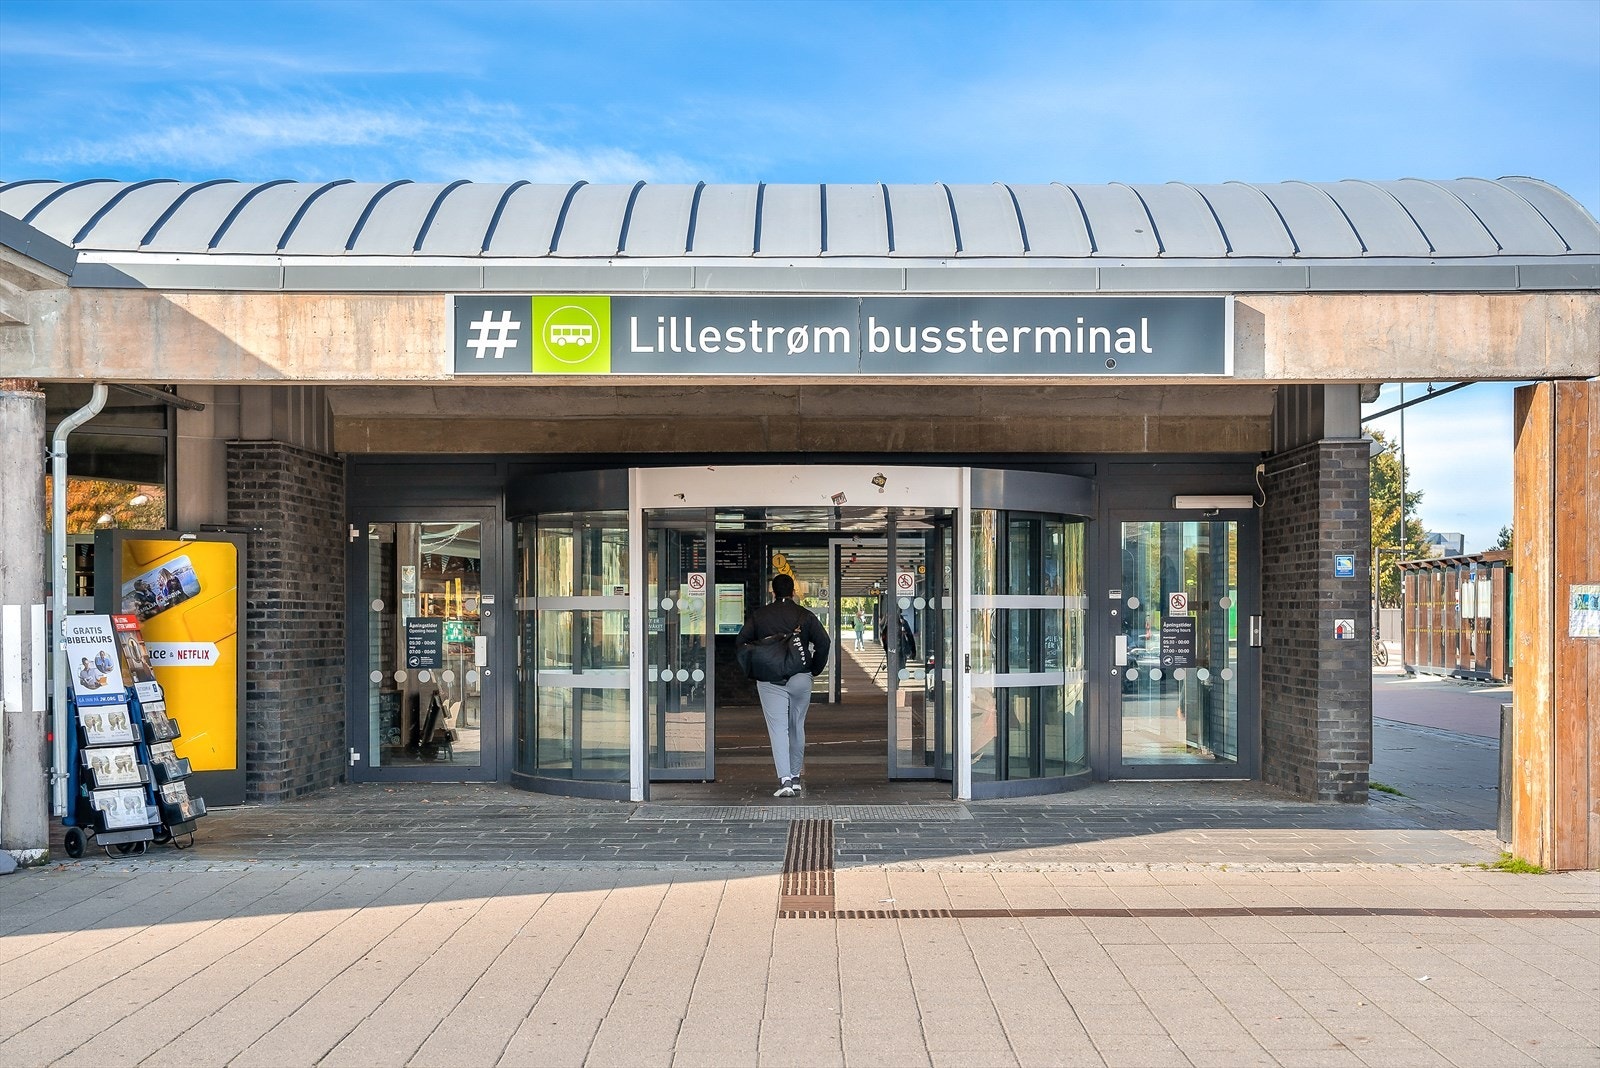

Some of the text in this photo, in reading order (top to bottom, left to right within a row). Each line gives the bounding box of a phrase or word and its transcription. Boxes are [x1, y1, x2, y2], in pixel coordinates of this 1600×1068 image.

[629, 316, 851, 355] Lillestrøm
[868, 316, 1153, 354] bussterminal
[73, 627, 103, 635] GRATIS
[67, 636, 113, 644] BIBELKURS
[149, 646, 166, 659] ice
[177, 650, 210, 660] NETFLIX
